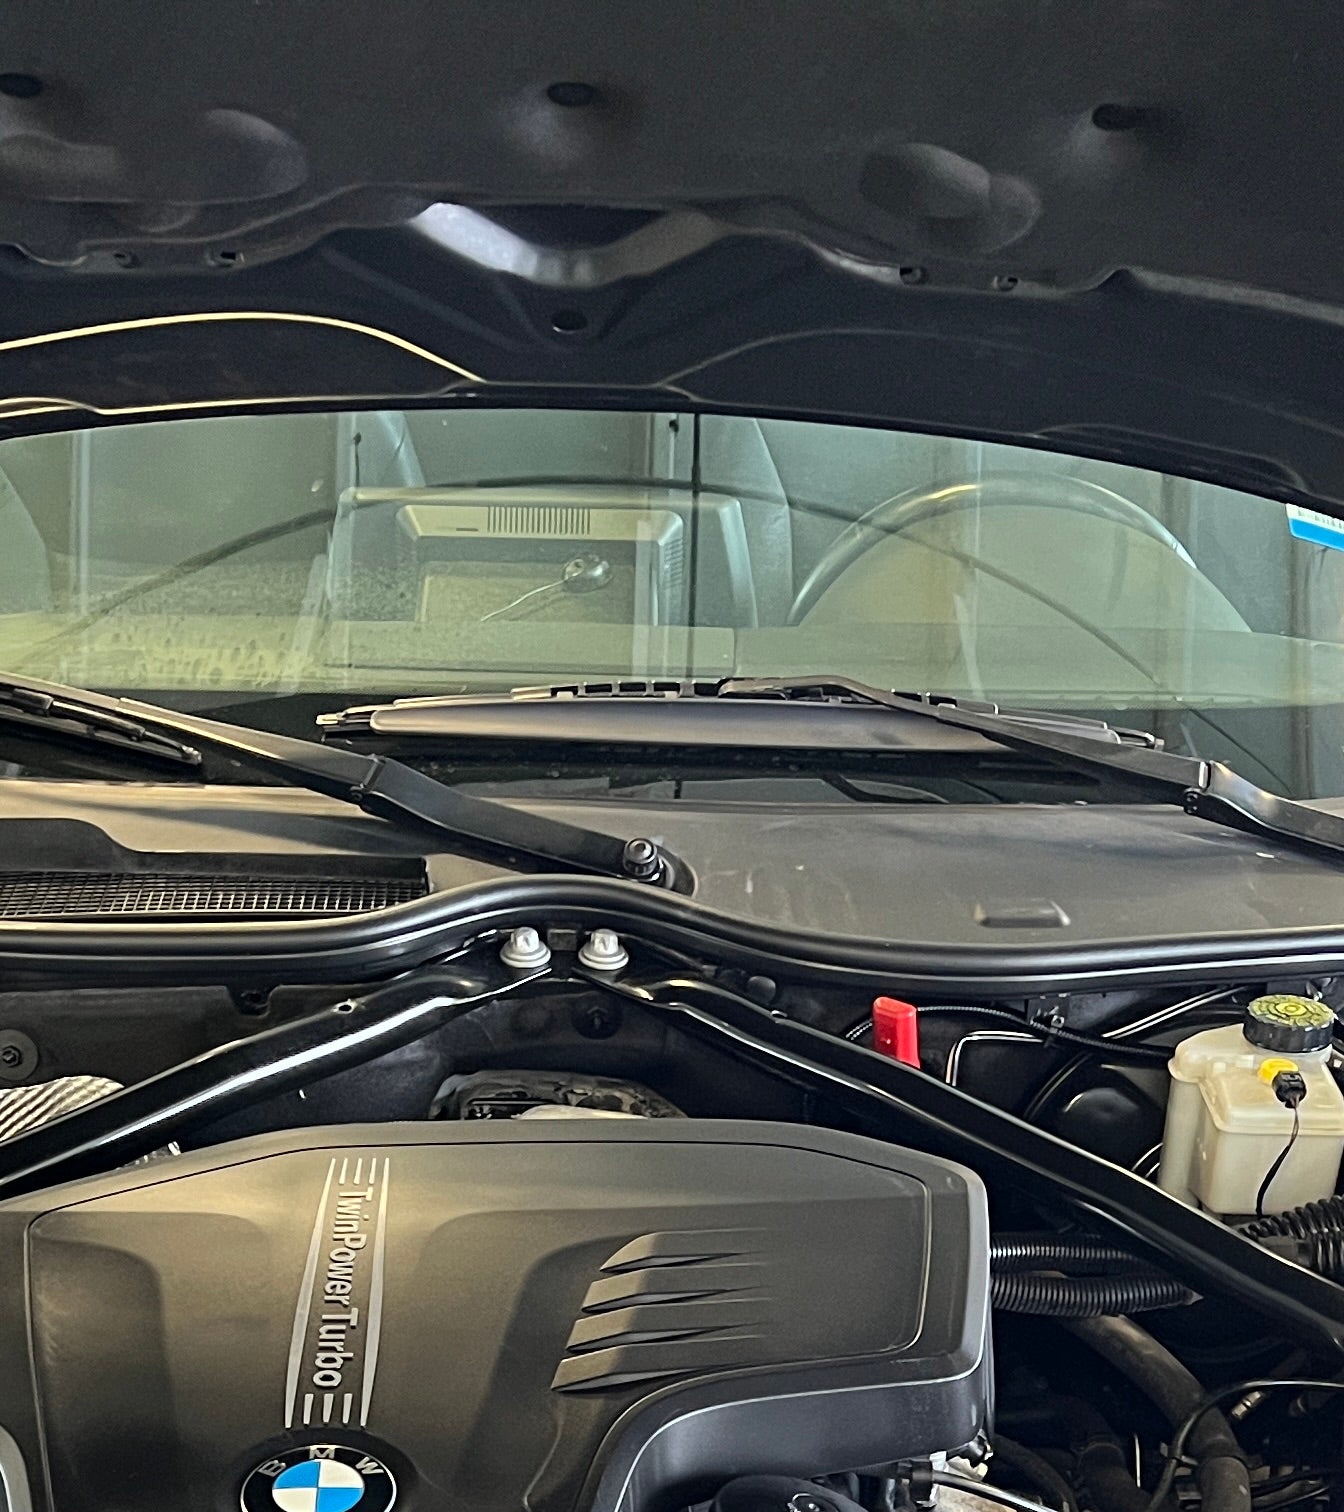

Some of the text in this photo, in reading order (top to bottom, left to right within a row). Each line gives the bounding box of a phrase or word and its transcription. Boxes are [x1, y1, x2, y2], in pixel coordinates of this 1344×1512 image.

[312, 1186, 373, 1387] TwinPower Turbo
[258, 1445, 385, 1477] BMW
